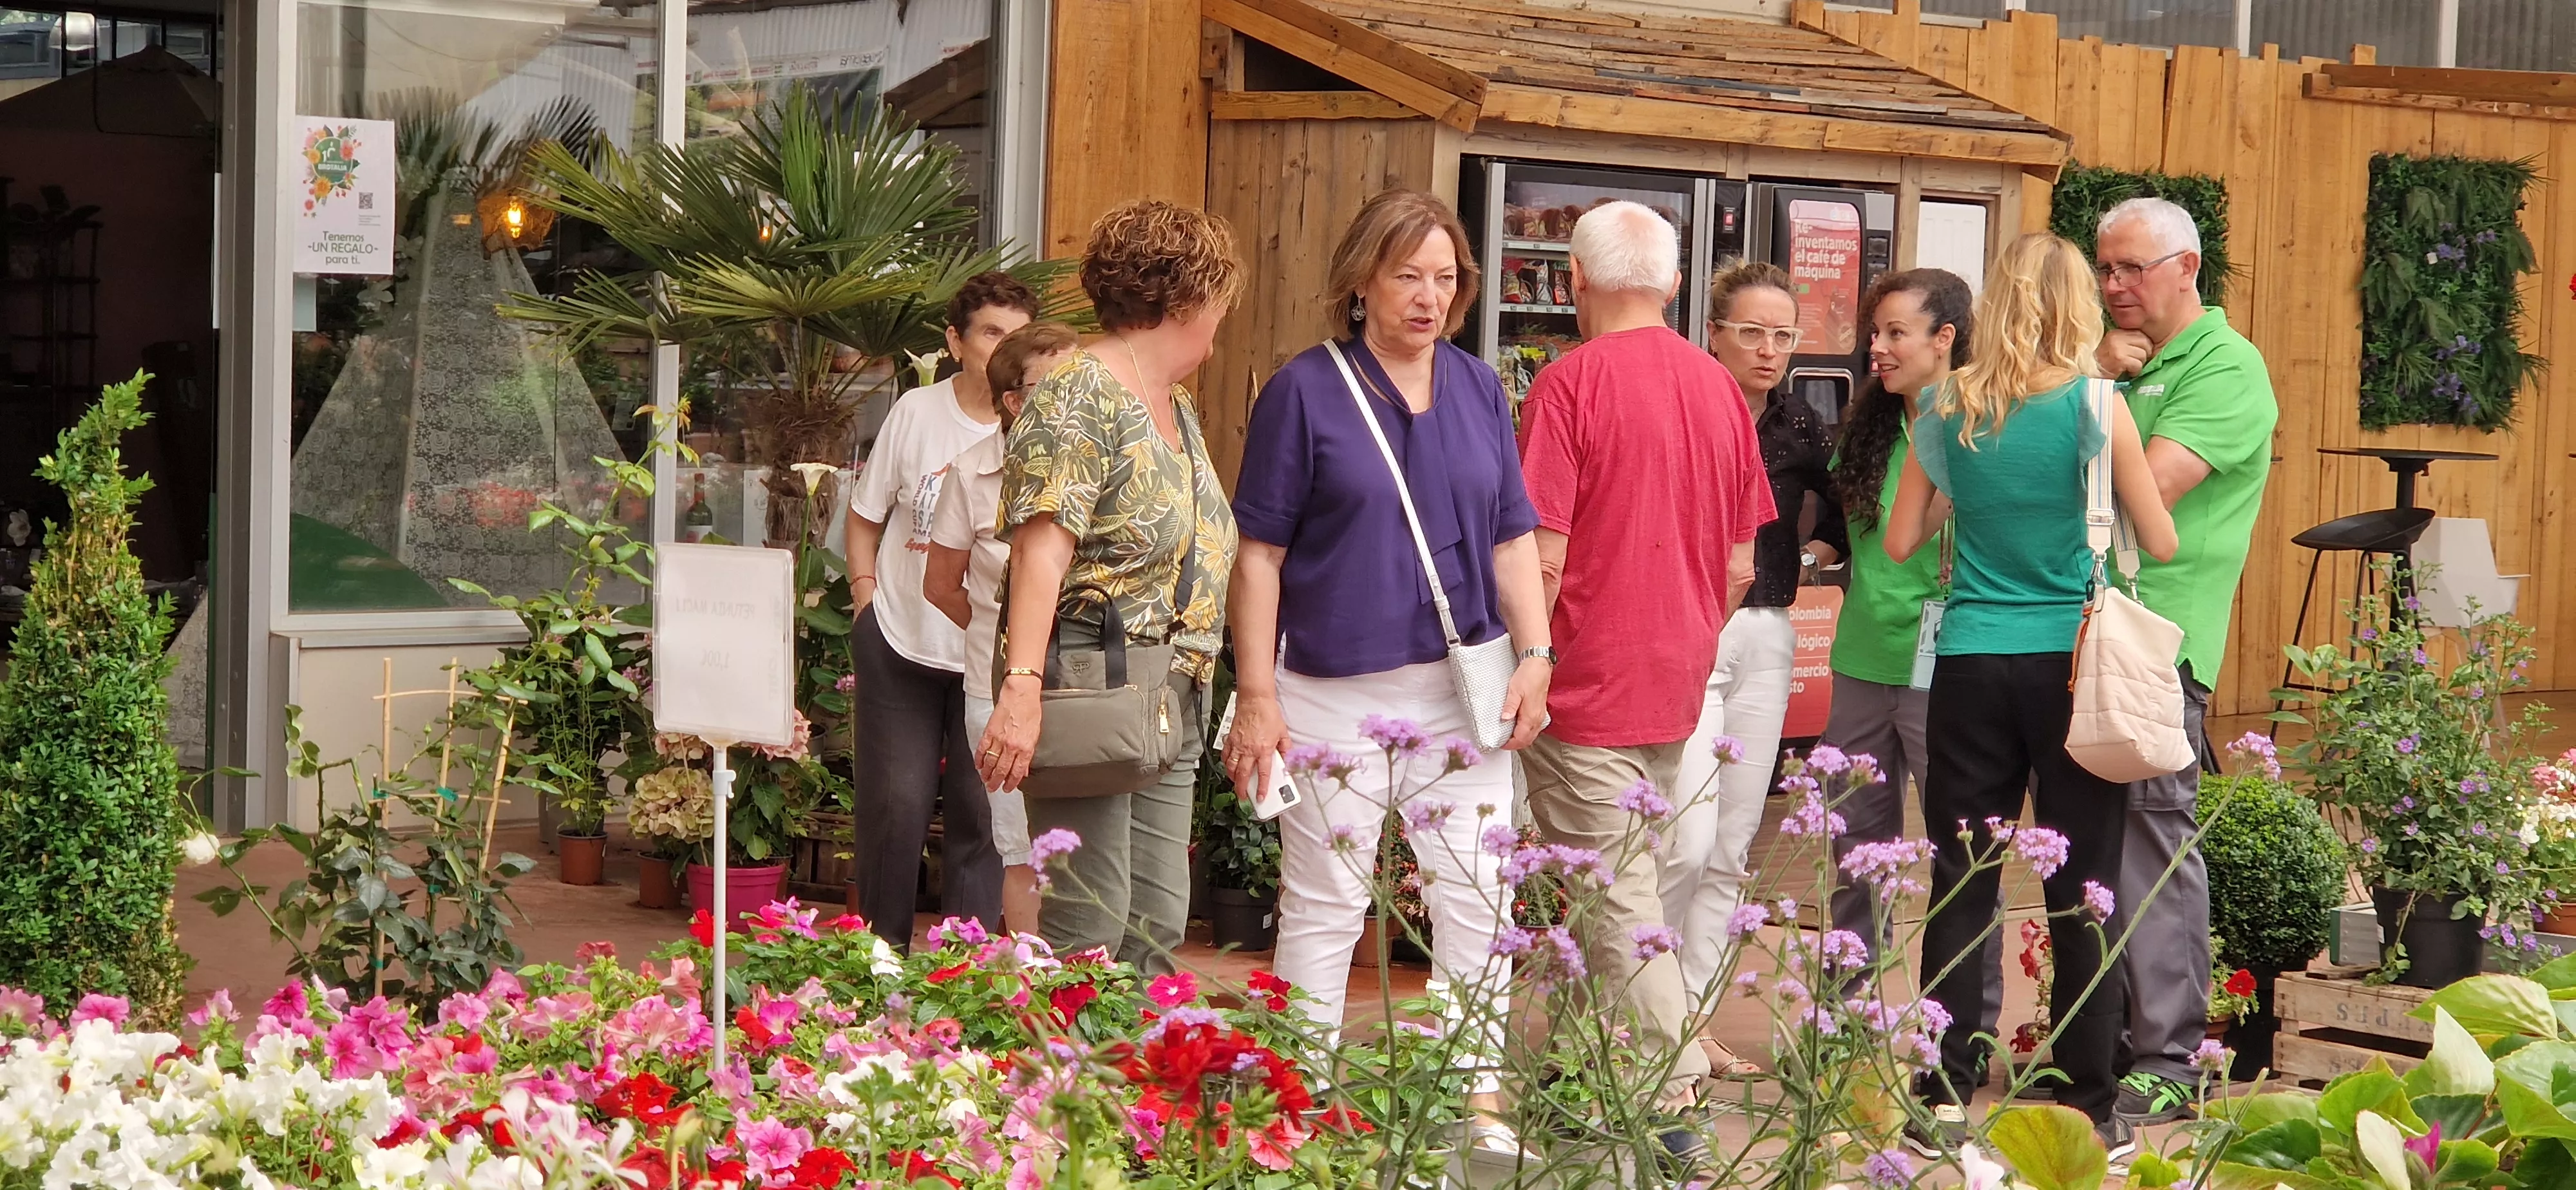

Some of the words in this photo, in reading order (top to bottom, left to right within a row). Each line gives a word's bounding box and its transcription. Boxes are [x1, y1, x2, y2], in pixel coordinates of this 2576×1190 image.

[323, 231, 365, 242] Tenemos
[1795, 232, 1857, 251] inventamos
[325, 256, 348, 266] para
[1795, 248, 1805, 263] el
[1807, 249, 1830, 264] café
[1832, 250, 1846, 266] de
[1794, 262, 1841, 281] máquina
[913, 474, 927, 506] WORLD
[1789, 606, 1831, 620] olombia
[1791, 663, 1829, 678] mercio
